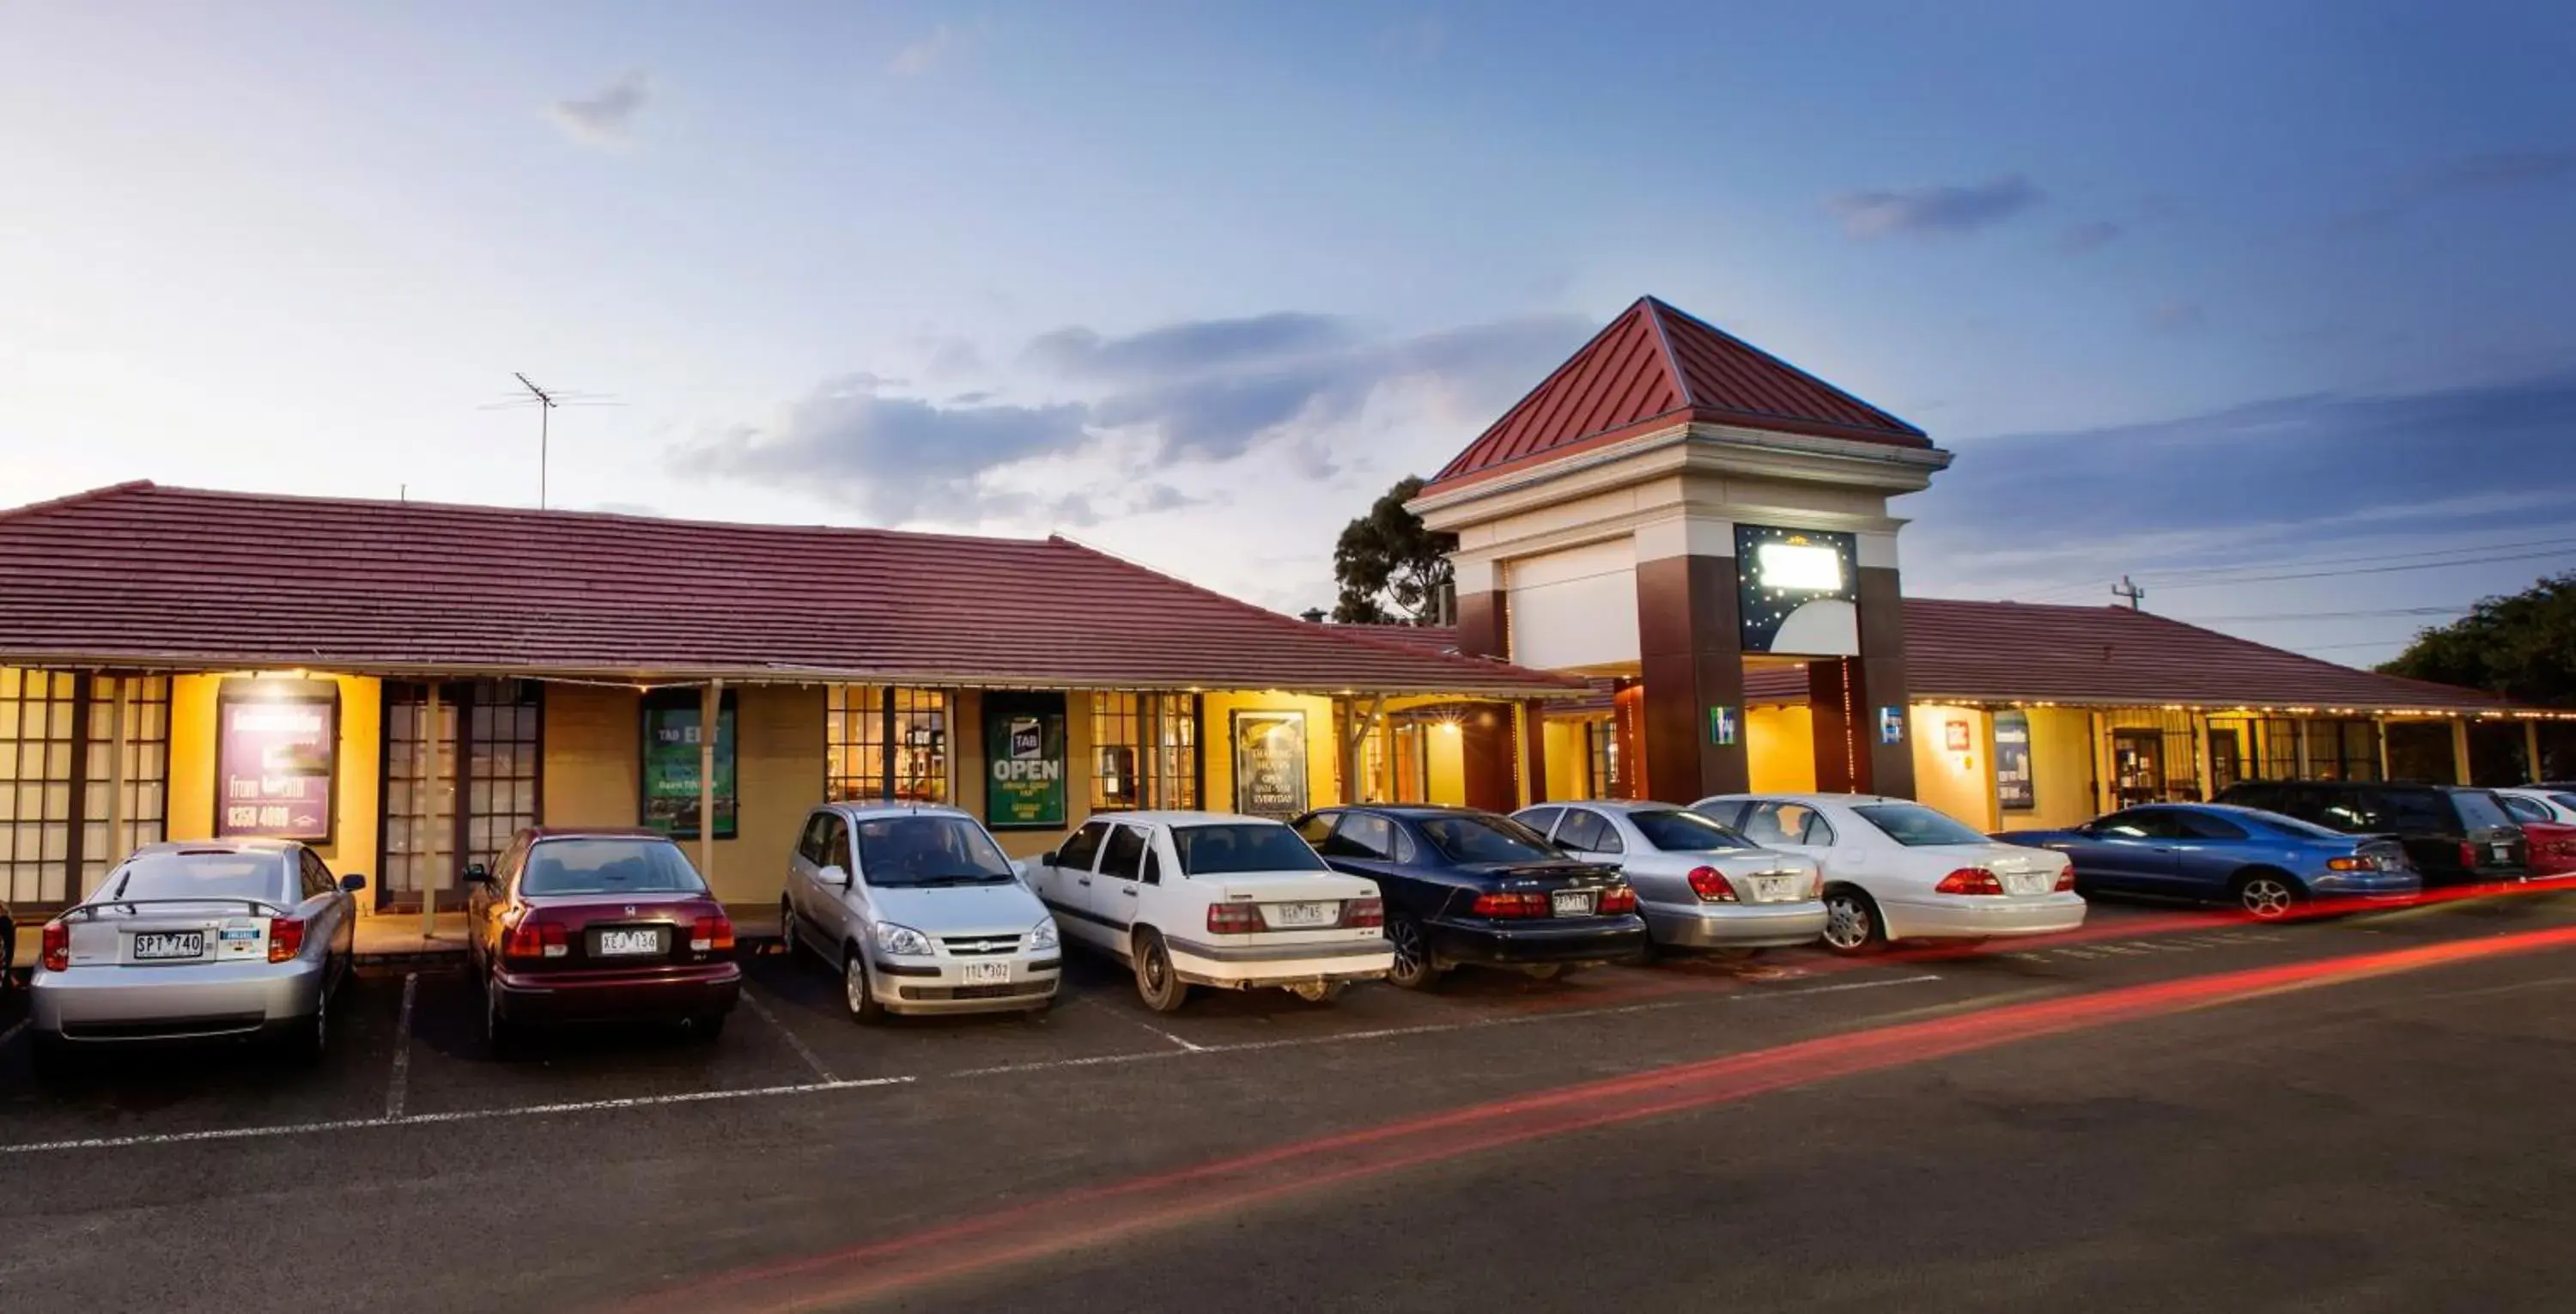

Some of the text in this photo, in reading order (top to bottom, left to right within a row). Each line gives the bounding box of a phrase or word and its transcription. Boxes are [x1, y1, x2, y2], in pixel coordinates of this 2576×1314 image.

[1015, 734, 1038, 748] TAB
[993, 759, 1059, 781] OPEN
[137, 935, 200, 952] SPT 740
[635, 933, 656, 948] 136
